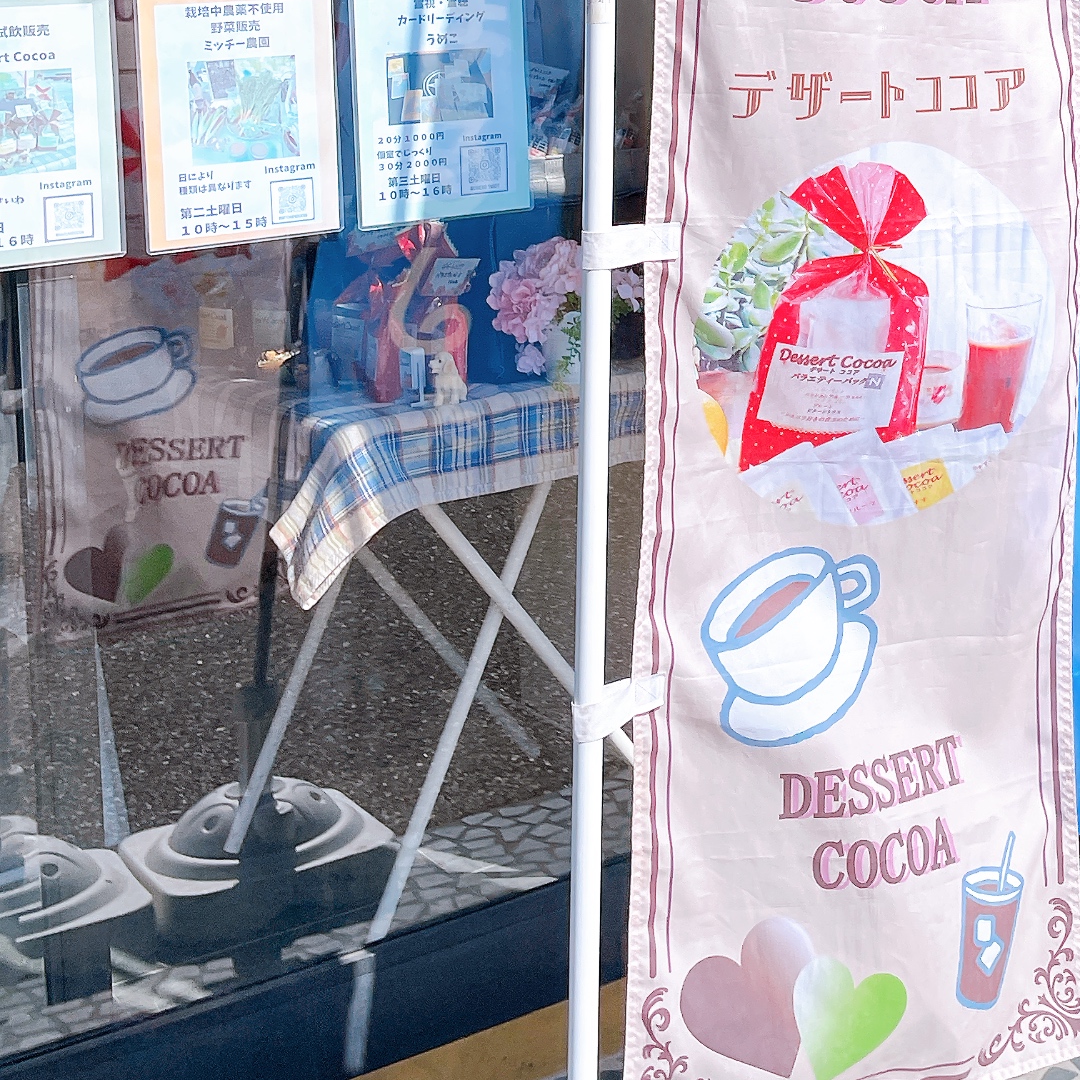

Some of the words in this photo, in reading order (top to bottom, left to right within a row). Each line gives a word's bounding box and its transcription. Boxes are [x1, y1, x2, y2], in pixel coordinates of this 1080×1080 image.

[184, 3, 284, 18] 栽培中農薬不使用
[397, 11, 485, 26] カードリーディング
[211, 20, 261, 34] 野菜販売
[13, 51, 56, 62] Cocoa
[728, 67, 1026, 120] デザートココア
[264, 162, 316, 175] Instagram
[178, 170, 214, 183] 日により
[388, 172, 441, 187] 第三土曜日
[39, 179, 93, 190] Instagram
[180, 202, 243, 220] 第二土曜日
[779, 348, 840, 367] Dessert
[841, 355, 898, 370] Cocoa
[778, 734, 965, 820] DESSERT
[812, 816, 961, 891] COCOA
